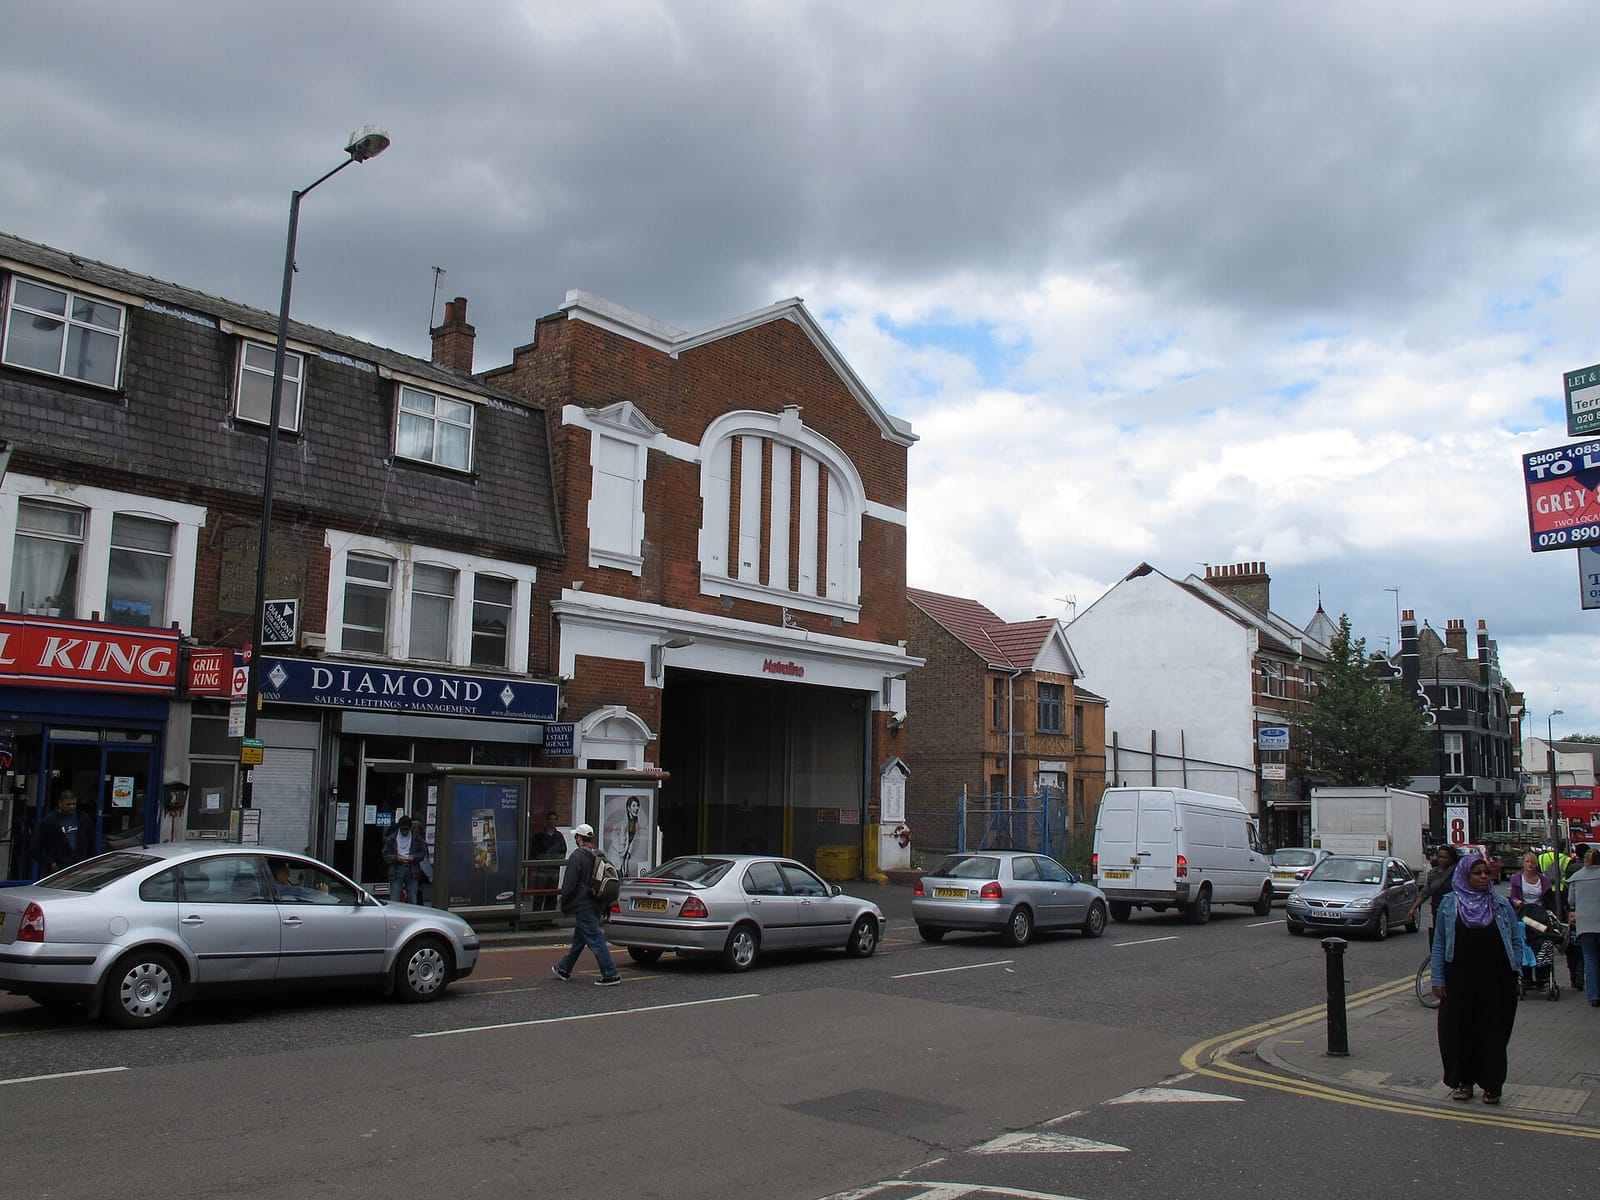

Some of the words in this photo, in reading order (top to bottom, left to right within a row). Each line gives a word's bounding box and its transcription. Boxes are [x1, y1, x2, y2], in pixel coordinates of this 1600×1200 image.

[1568, 375, 1587, 387] LET
[1589, 372, 1598, 382] &
[1577, 413, 1594, 424] 020
[1529, 451, 1563, 466] SHOP
[1566, 443, 1600, 459] 1,083
[1530, 460, 1573, 479] TO
[1583, 454, 1600, 469] L
[1536, 489, 1586, 514] GREY
[1554, 518, 1574, 528] TWO
[1576, 513, 1600, 524] LOCA
[1538, 531, 1567, 546] 020
[1571, 525, 1600, 541] 890
[268, 603, 294, 637] DIAMOND
[37, 636, 172, 677] KING
[192, 658, 220, 671] GRILL
[192, 672, 219, 686] KING
[311, 667, 483, 702] DIAMOND
[314, 695, 345, 705] SALES
[354, 698, 402, 709] LETTINGS
[411, 702, 477, 714] MANAGEMENT
[1451, 818, 1466, 845] 8
